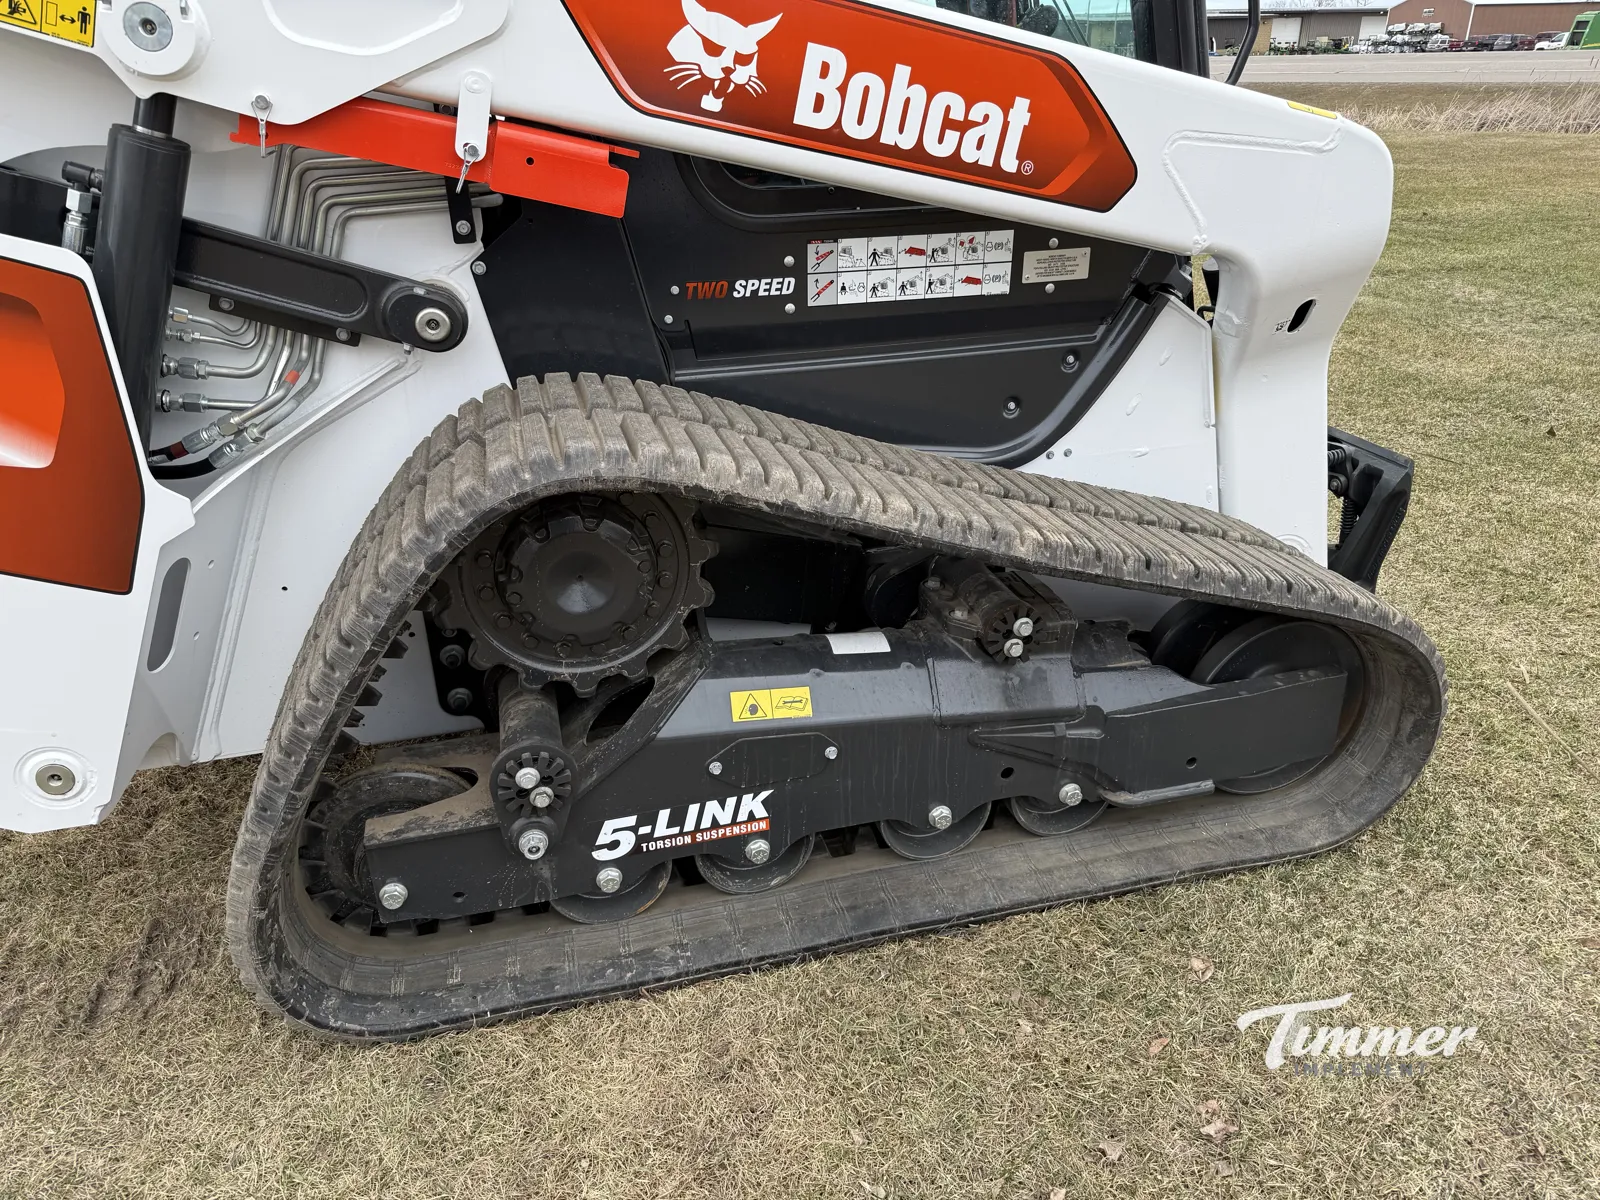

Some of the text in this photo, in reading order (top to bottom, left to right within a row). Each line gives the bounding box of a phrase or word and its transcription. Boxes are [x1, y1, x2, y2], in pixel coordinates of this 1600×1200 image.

[793, 42, 1031, 173] Bobcat
[685, 277, 796, 300] TWO SPEED
[591, 789, 775, 861] 5-LINK
[641, 821, 767, 852] TORSION SUSPENSION
